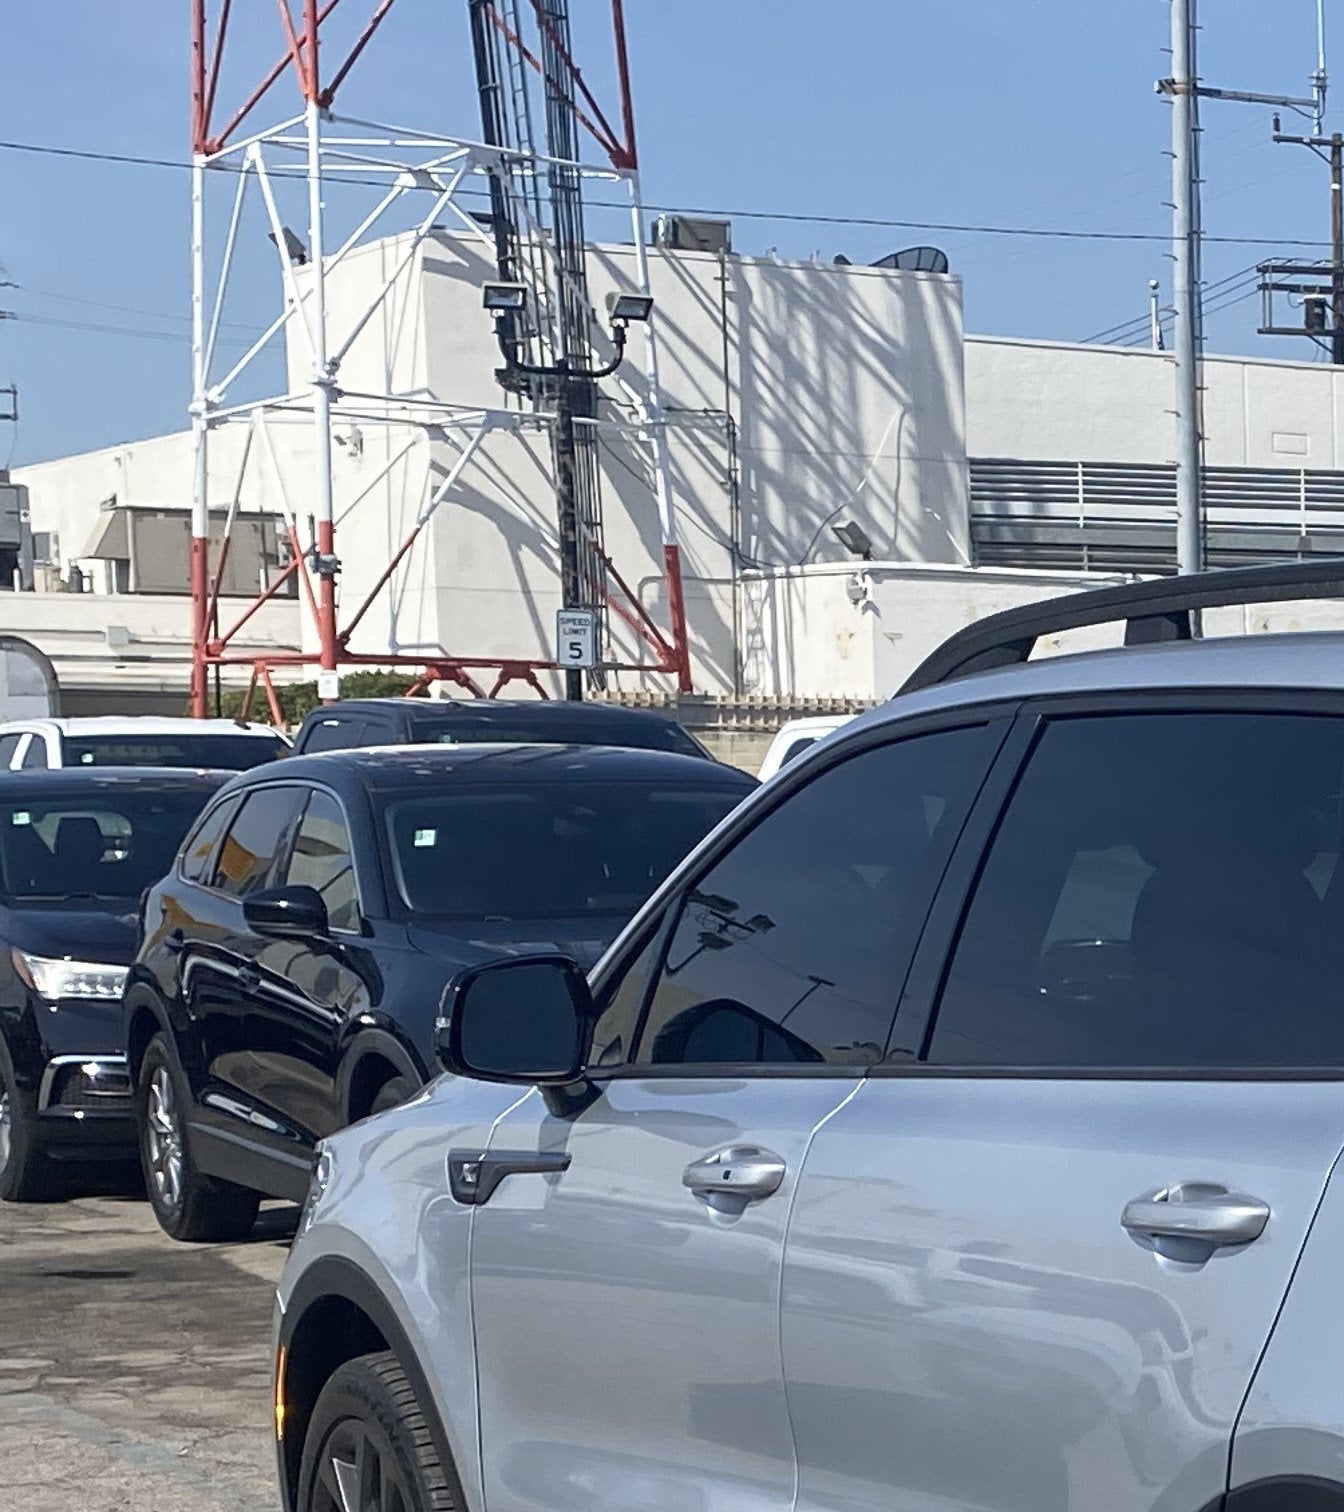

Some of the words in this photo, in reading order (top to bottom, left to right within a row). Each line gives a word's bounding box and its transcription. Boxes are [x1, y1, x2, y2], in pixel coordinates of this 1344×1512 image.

[559, 617, 591, 626] SPEED
[563, 628, 587, 636] LIMIT
[569, 641, 583, 659] 5
